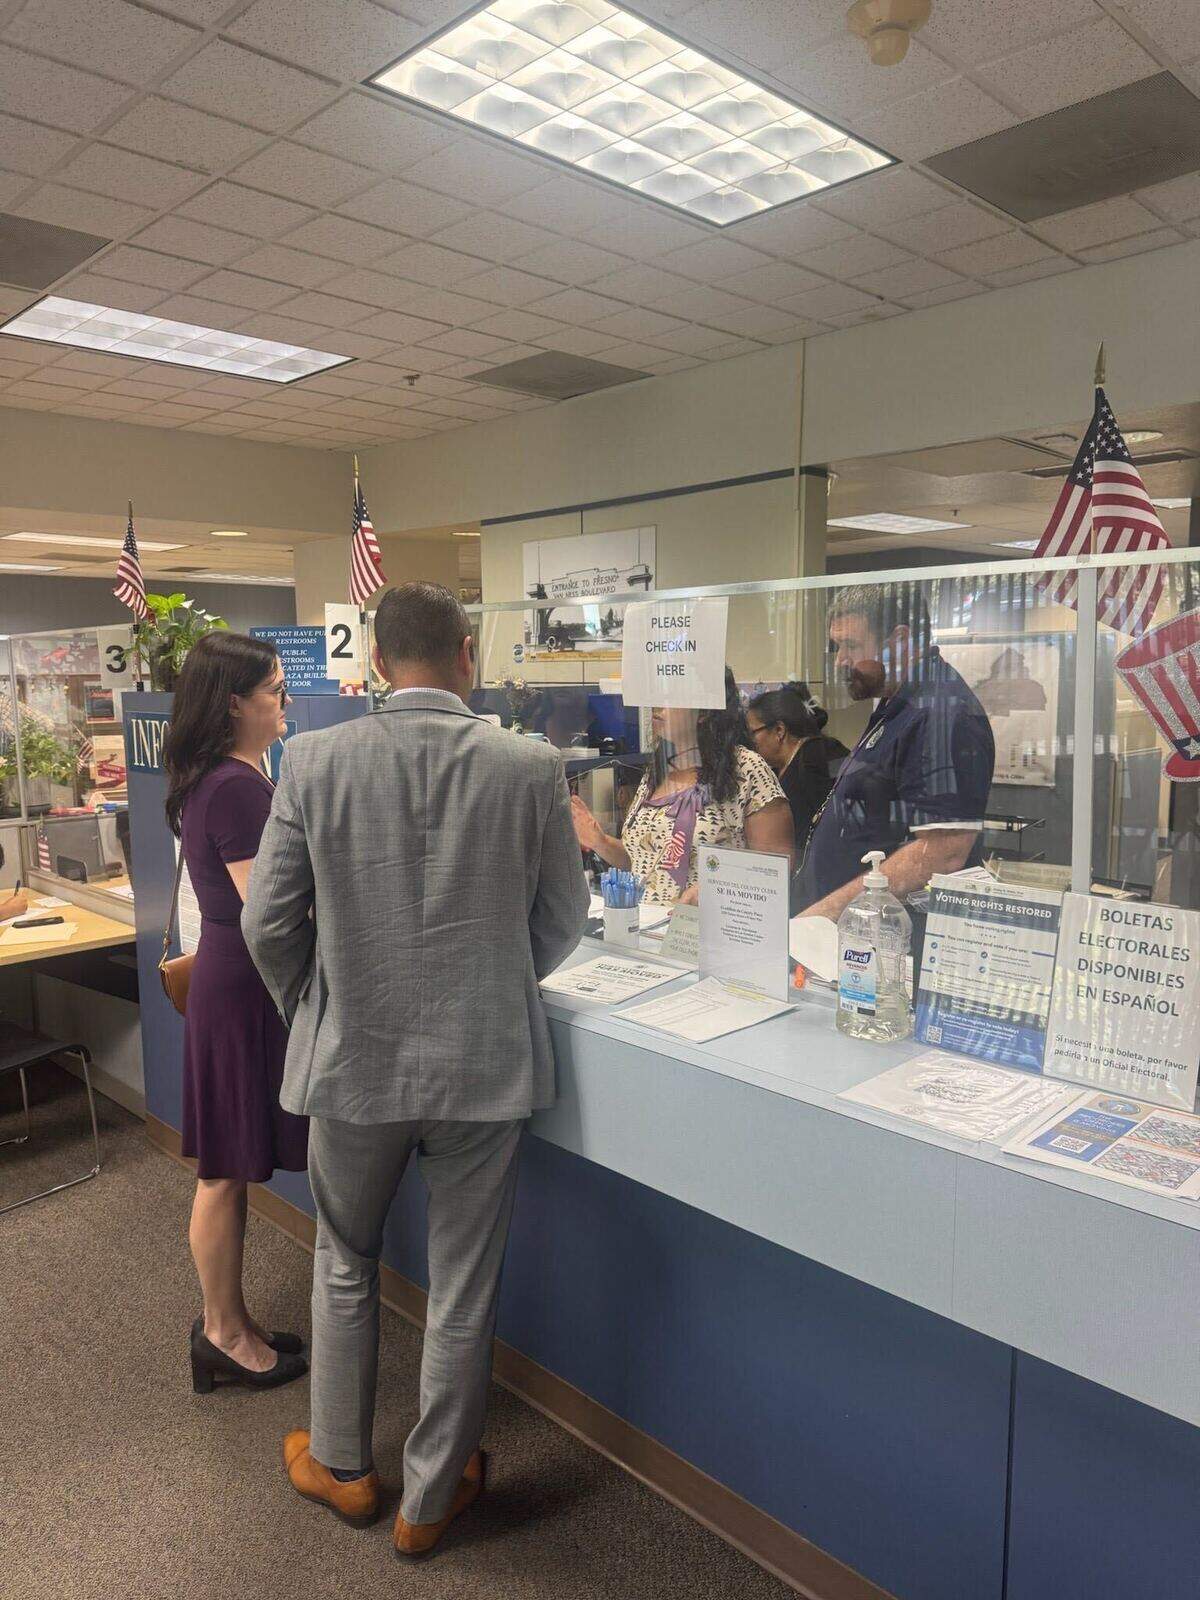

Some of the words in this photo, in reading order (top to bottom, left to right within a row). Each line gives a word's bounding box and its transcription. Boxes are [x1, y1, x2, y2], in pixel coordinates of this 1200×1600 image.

[651, 616, 691, 629] PLEASE
[331, 623, 354, 659] 2
[645, 640, 682, 653] CHECK
[684, 640, 697, 652] IN
[106, 645, 127, 673] 3
[656, 664, 685, 676] HERE
[716, 887, 725, 895] SE
[726, 889, 736, 897] HA
[738, 891, 767, 902] MOVIDO
[936, 891, 969, 906] VOTING
[971, 899, 1003, 911] RIGHTS
[1005, 904, 1052, 919] RESTORED
[1100, 908, 1173, 931] BOLETAS
[1079, 932, 1190, 961] ELECTORALES
[1077, 958, 1185, 989] DISPONIBLES
[1076, 984, 1097, 1000] EN
[1102, 989, 1179, 1017] ESPAÑOL
[1090, 1057, 1100, 1065] un
[1103, 1059, 1128, 1071] Oficial
[1147, 1055, 1162, 1067] por
[1164, 1058, 1188, 1072] favor
